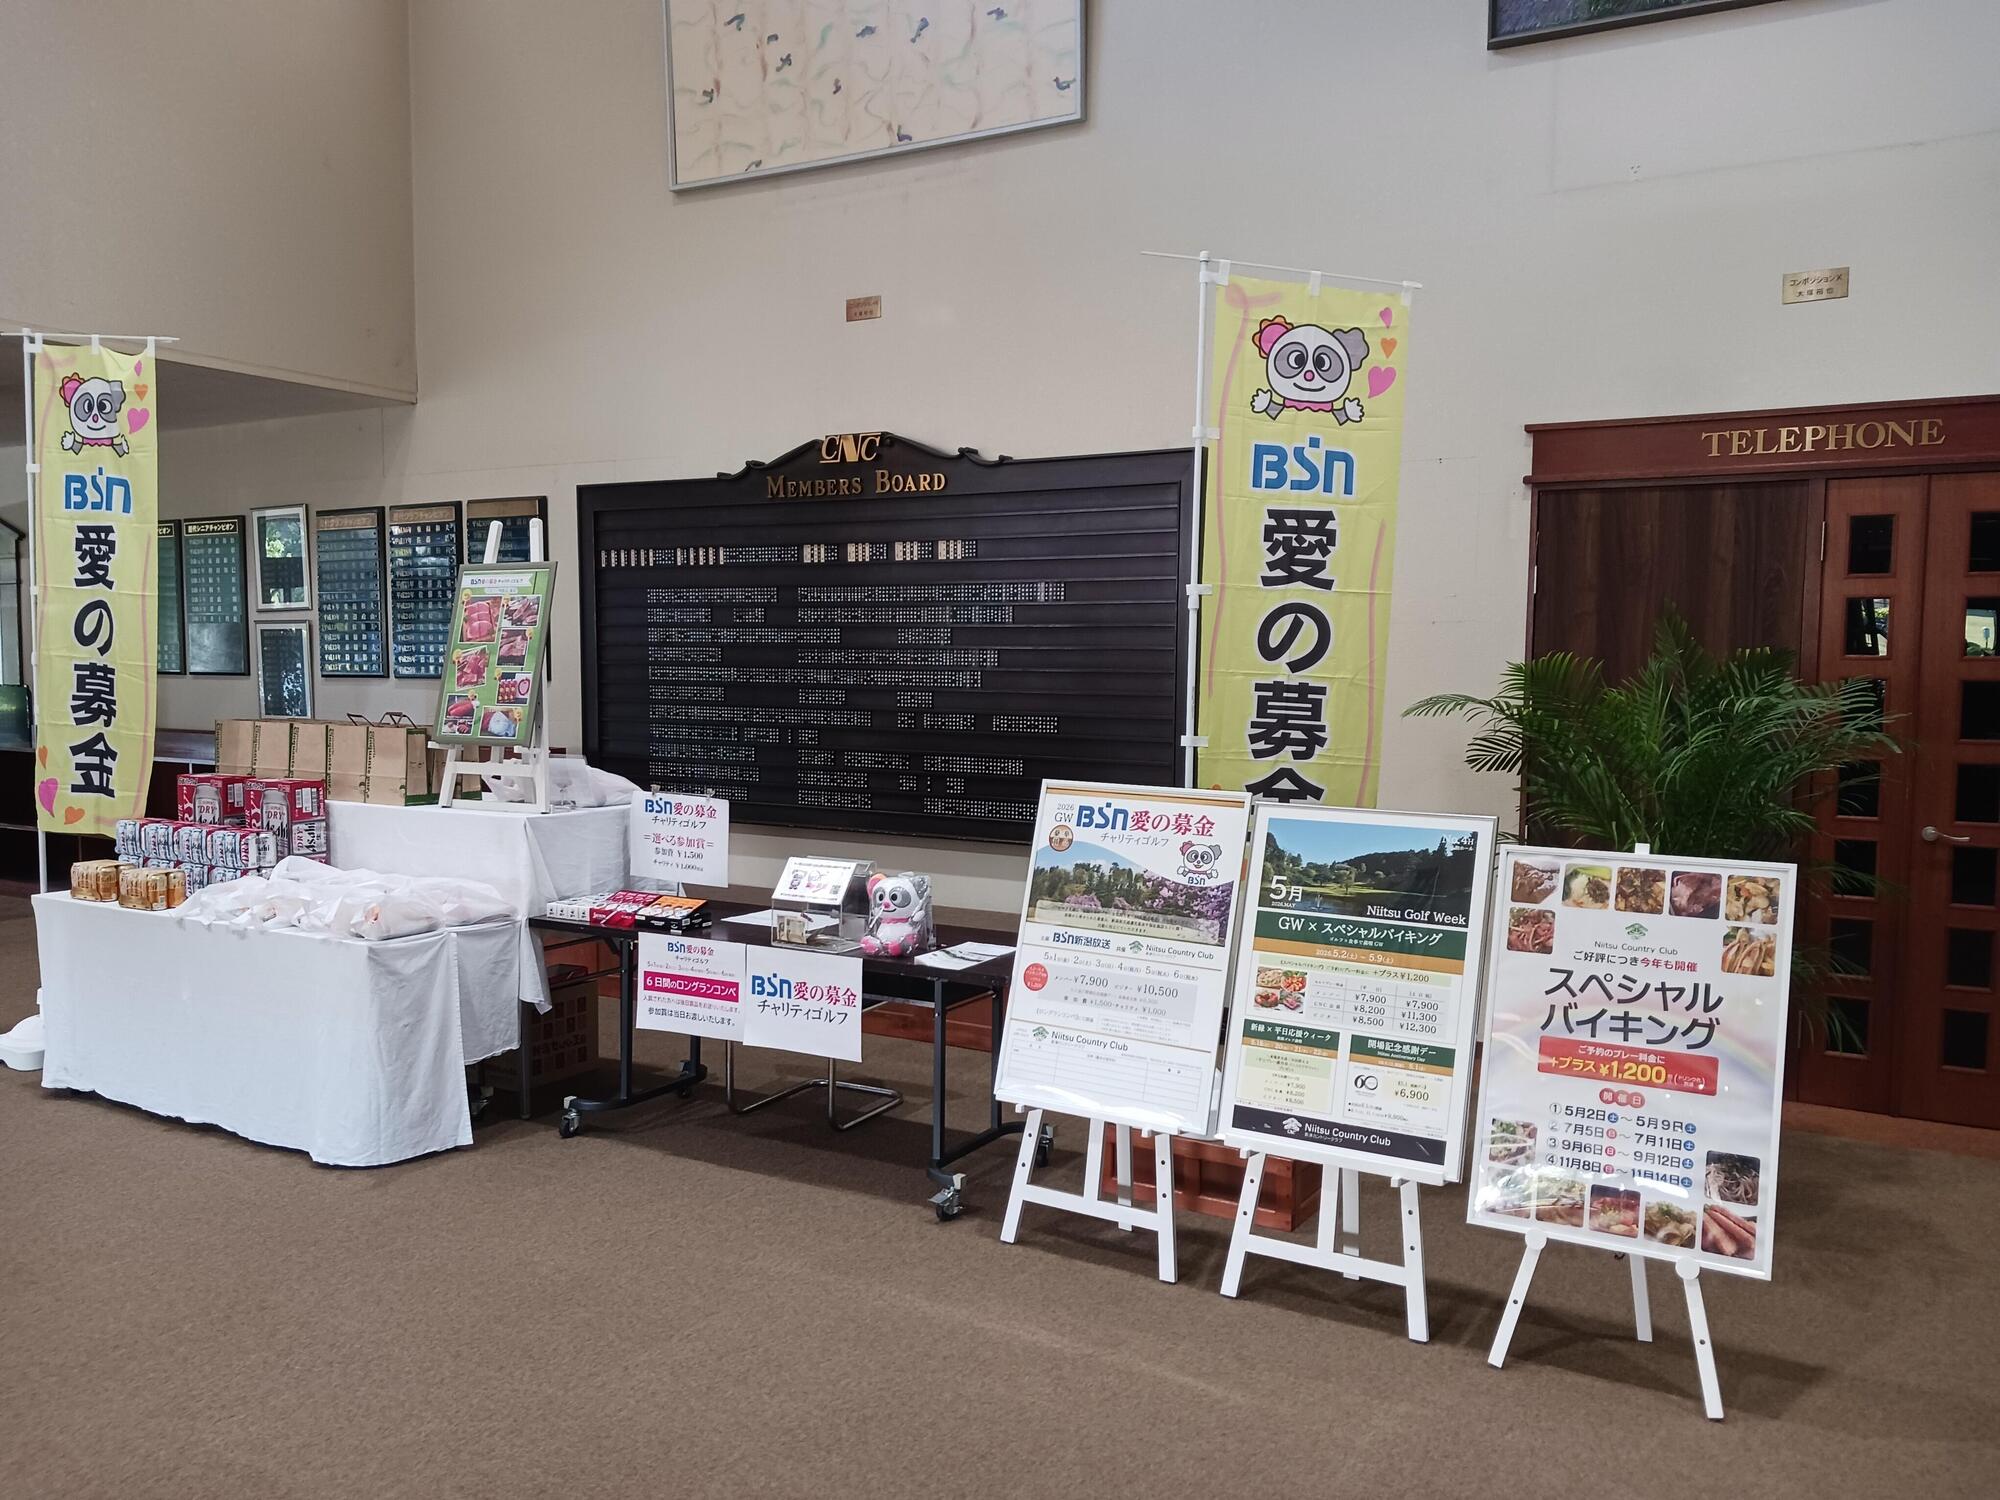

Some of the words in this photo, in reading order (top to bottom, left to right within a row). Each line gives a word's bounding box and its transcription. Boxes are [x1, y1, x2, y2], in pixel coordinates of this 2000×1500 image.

[820, 432, 881, 464] CNC
[1701, 418, 1946, 457] TELEPHONE
[766, 474, 863, 498] MEMBERS
[875, 470, 946, 494] BOARD
[69, 525, 118, 799] 愛の募金
[1054, 812, 1074, 823] GW
[1057, 803, 1074, 811] 2026
[652, 816, 707, 829] チャリティゴルフ
[1100, 832, 1169, 848] チャリティゴルフ
[1270, 875, 1302, 902] 5月
[1366, 904, 1402, 919] Niitsu
[1404, 908, 1430, 922] Golf
[1433, 912, 1467, 926] Week
[1278, 916, 1304, 931] GW
[1321, 922, 1444, 946] スペシャルバイキング
[1146, 944, 1166, 953] Niitsu
[1168, 946, 1196, 958] Country
[1198, 951, 1214, 960] Club
[1594, 941, 1618, 950] Niitsu
[1622, 943, 1655, 954] Country
[1659, 946, 1678, 955] Club
[1573, 950, 1698, 972] ご好評につき今年も開催
[1544, 968, 1724, 1014] スペシャル
[758, 1000, 848, 1024] チャリティゴルフ
[1540, 1002, 1721, 1050] バイキング
[1052, 1031, 1074, 1042] Niitsu
[1076, 1034, 1108, 1048] Country
[1110, 1040, 1128, 1051] Club
[1578, 1045, 1666, 1064] ご予約のプレー料金に
[1600, 1060, 1666, 1084] ¥1,200
[1304, 1123, 1330, 1135] Niitsu
[1332, 1128, 1368, 1144] Country
[1370, 1134, 1391, 1146] Club
